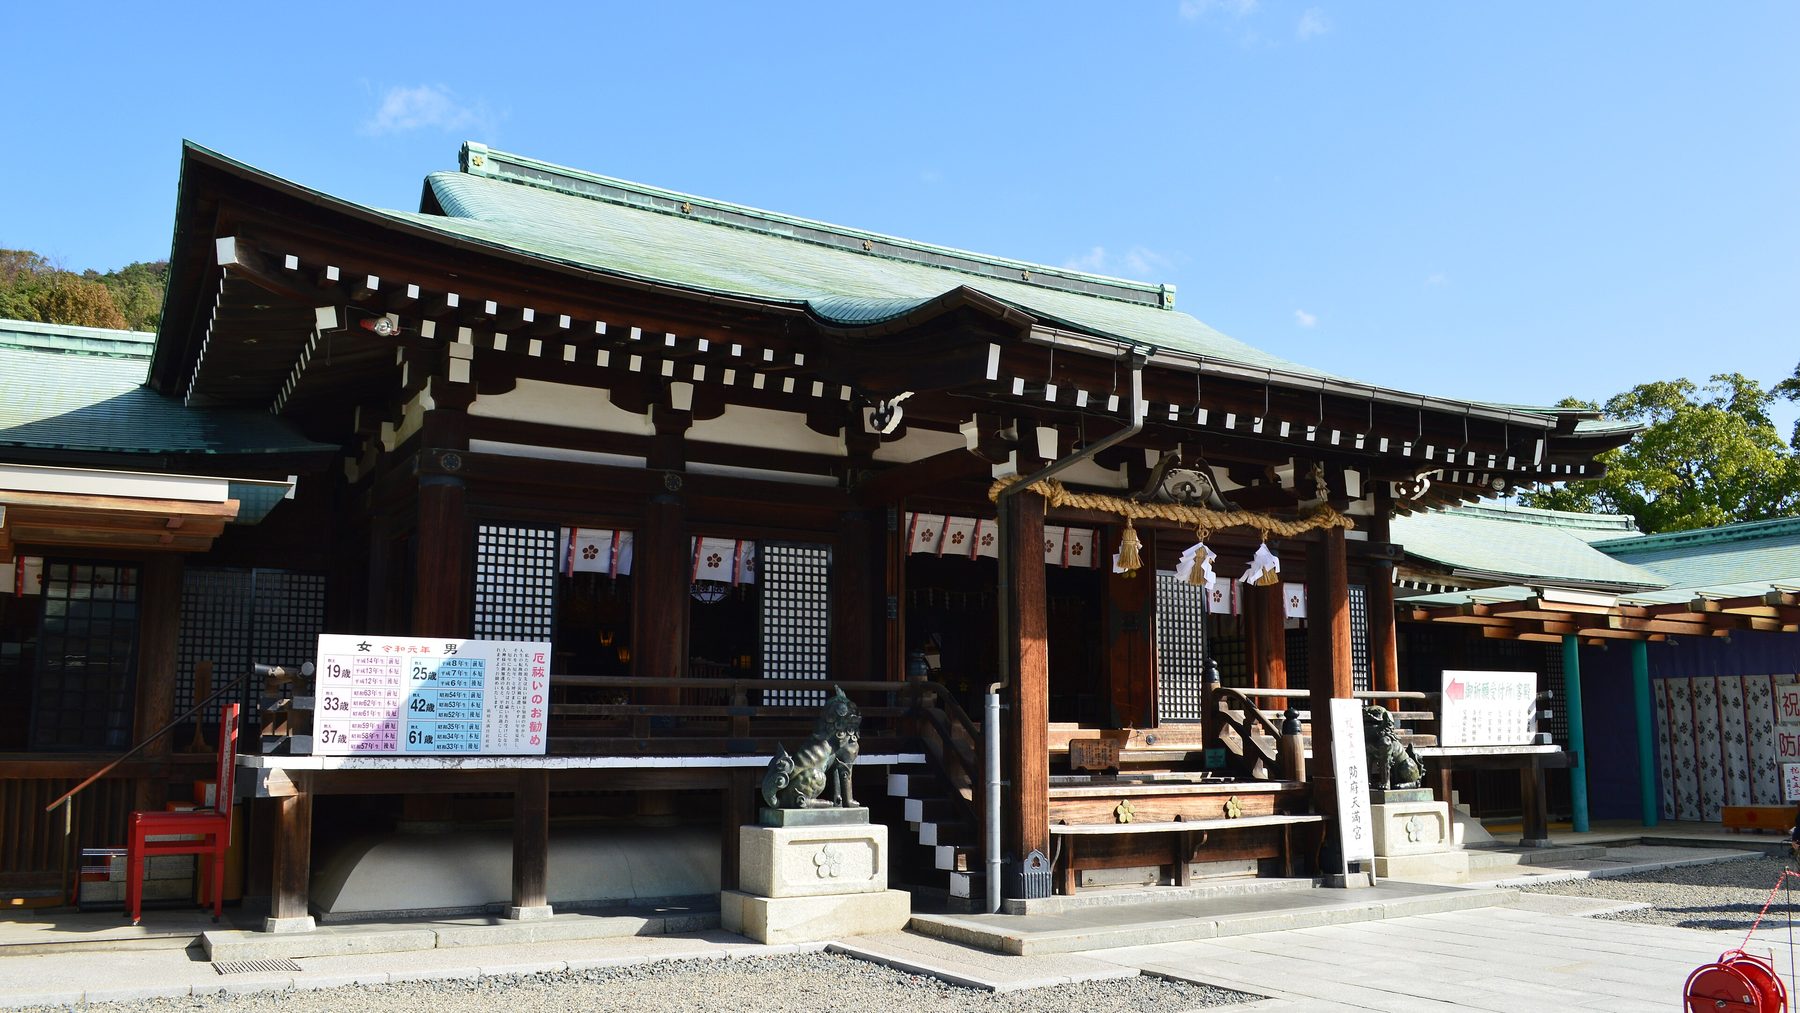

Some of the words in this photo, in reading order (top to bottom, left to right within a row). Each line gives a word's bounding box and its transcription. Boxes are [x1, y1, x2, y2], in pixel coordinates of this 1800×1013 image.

[357, 641, 372, 652] 女
[382, 645, 430, 653] 令和元年
[444, 644, 457, 655] 男
[327, 664, 351, 678] 19歳
[412, 667, 437, 681] 25歳
[323, 697, 349, 711] 33歳
[410, 699, 435, 713] 42歳
[529, 652, 545, 746] 厄祓いのお勧め
[1782, 692, 1800, 717] 祝
[322, 730, 347, 744] 37歳
[409, 730, 433, 745] 61歳
[1779, 732, 1800, 757] 防
[1349, 765, 1362, 840] 防府天満宮
